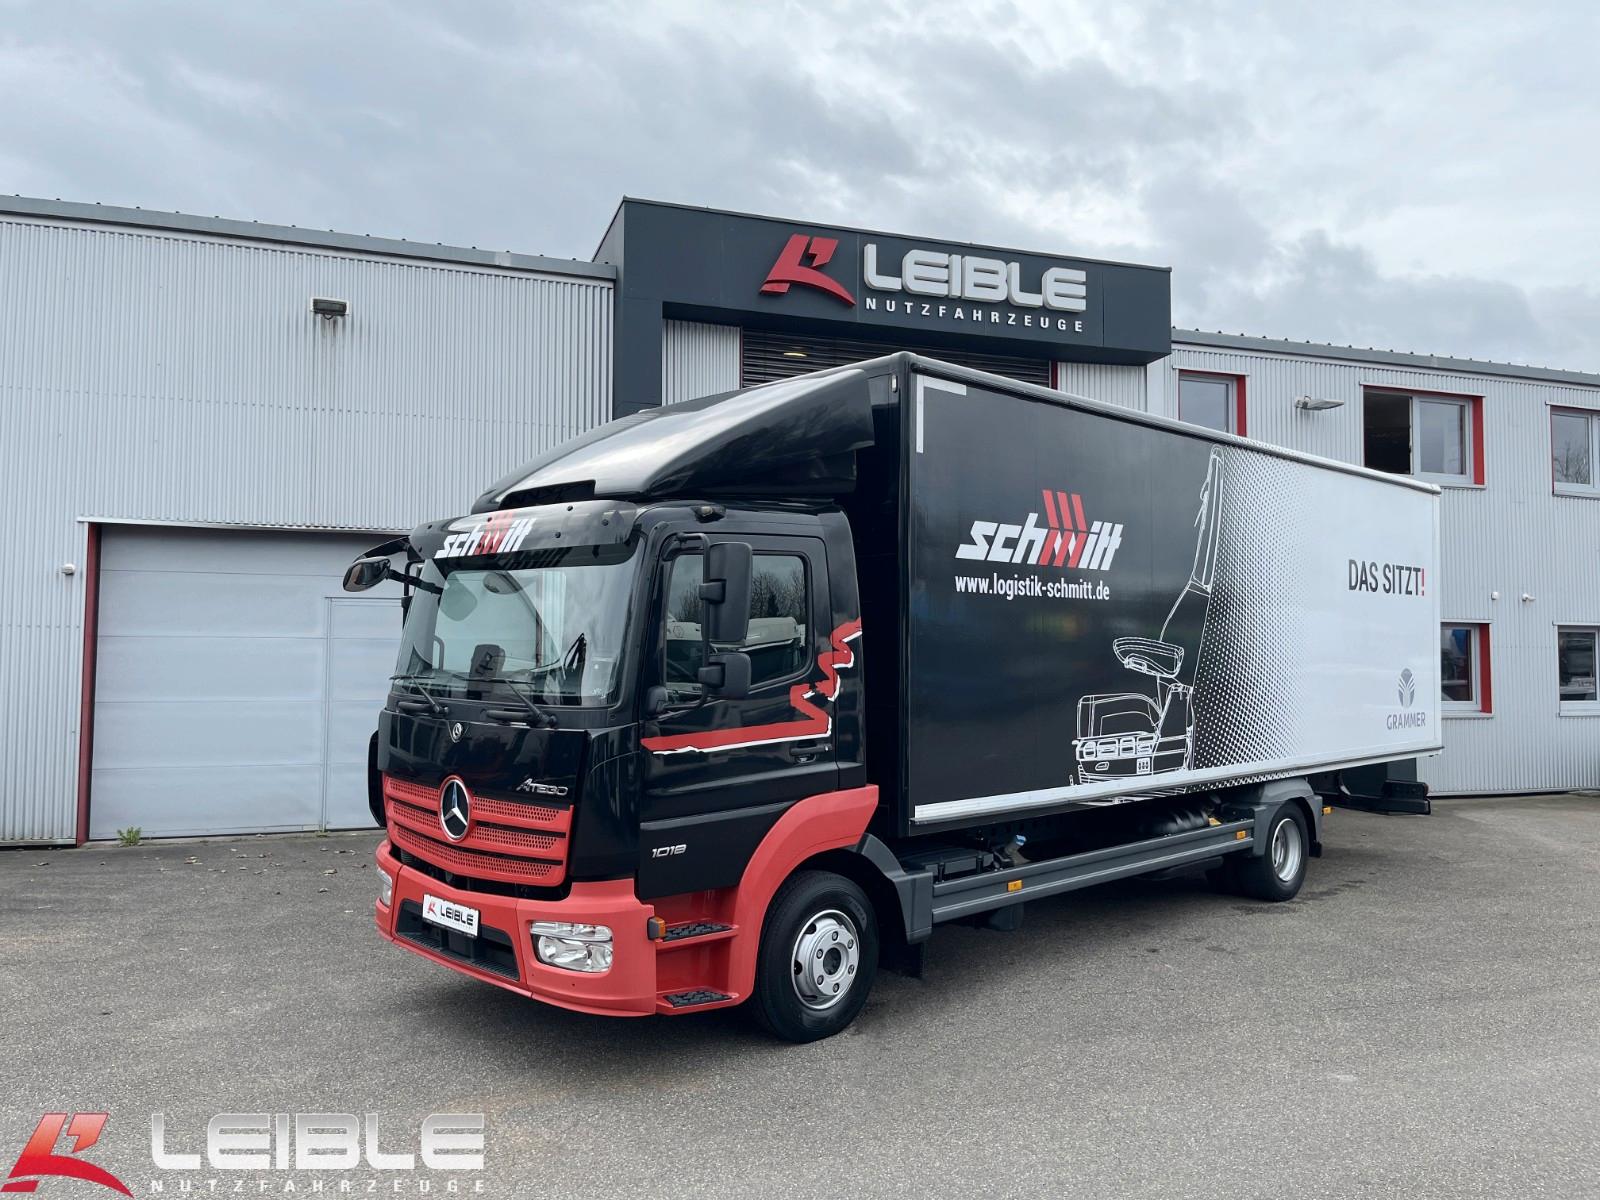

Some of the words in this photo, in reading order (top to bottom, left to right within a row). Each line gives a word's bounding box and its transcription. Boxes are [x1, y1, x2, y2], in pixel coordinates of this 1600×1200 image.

[864, 243, 1087, 313] LEIBLE
[865, 298, 1083, 332] NUTZFAHRZEUGE
[955, 489, 1124, 571] schmitt
[954, 572, 1110, 601] www.logistik-schmitt.de
[1348, 559, 1379, 593] DAS
[1382, 563, 1425, 596] SITZT!
[1386, 711, 1426, 731] GRAMMER
[652, 844, 687, 859] 1018
[440, 904, 474, 927] LEIBLE
